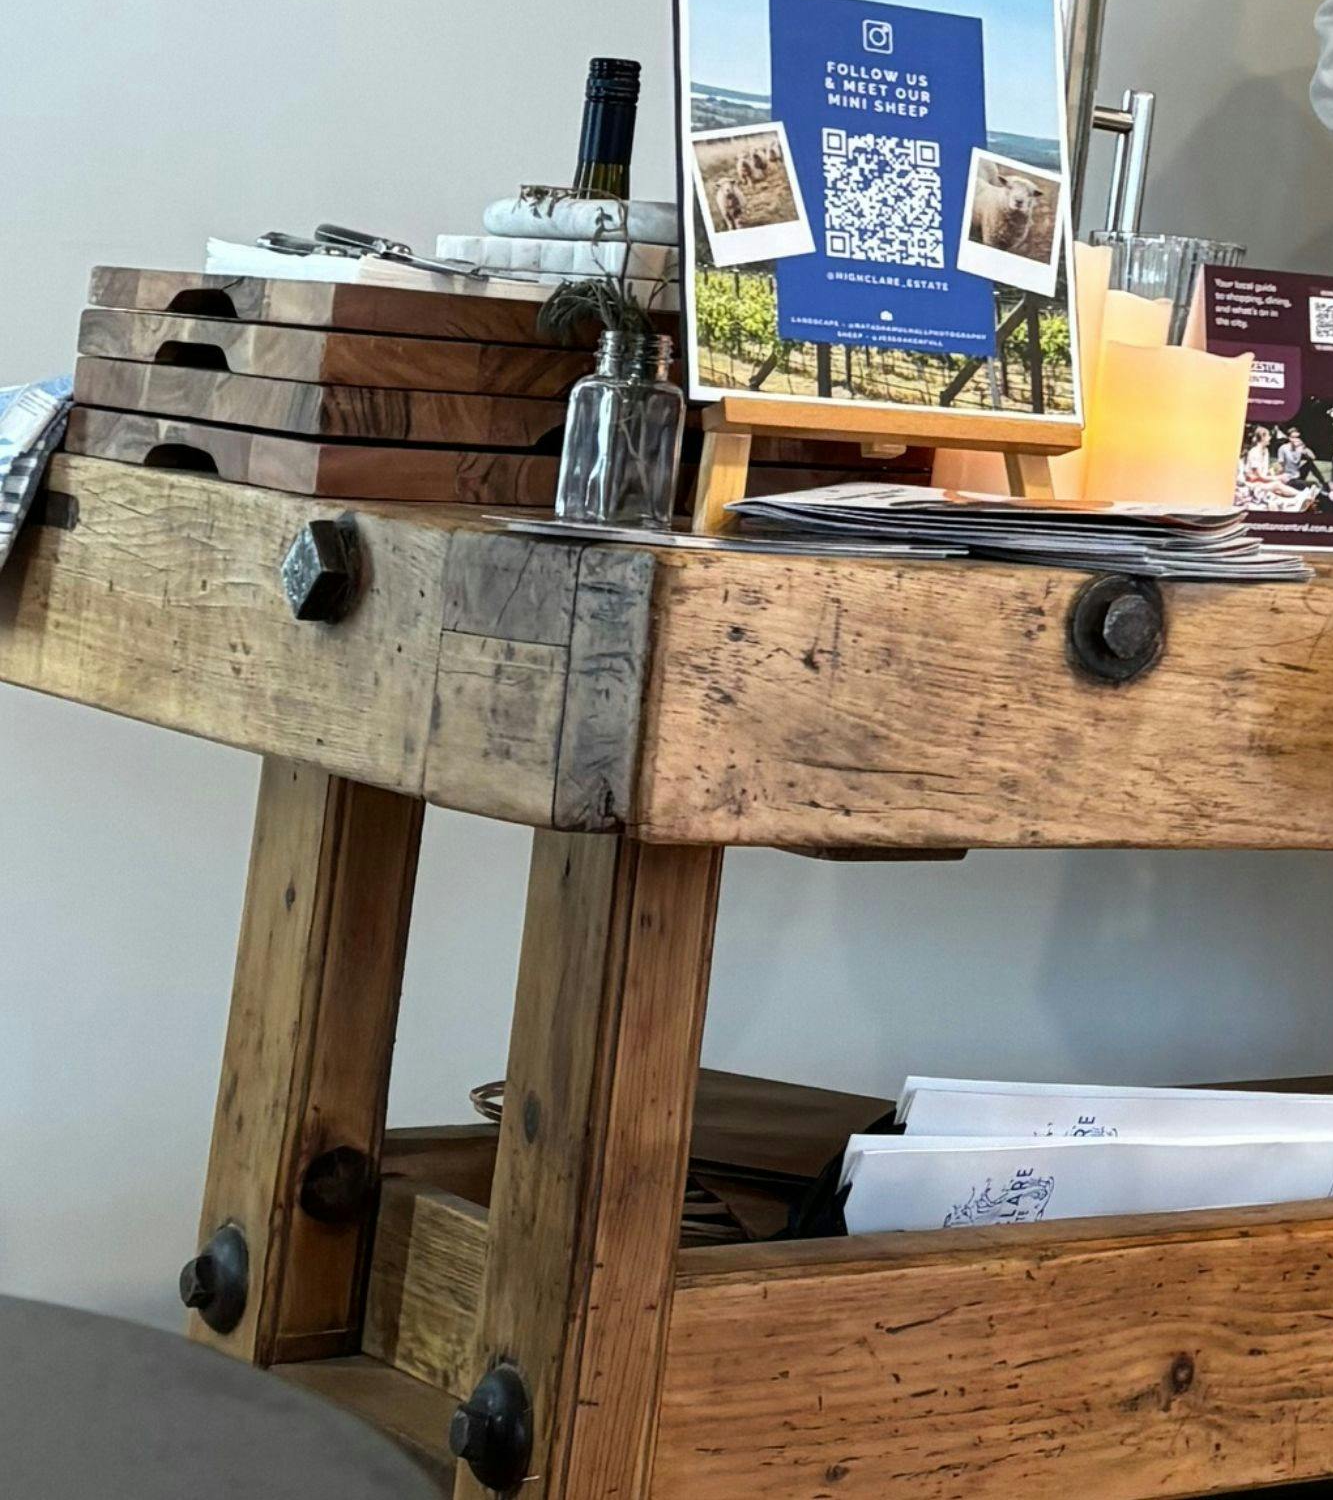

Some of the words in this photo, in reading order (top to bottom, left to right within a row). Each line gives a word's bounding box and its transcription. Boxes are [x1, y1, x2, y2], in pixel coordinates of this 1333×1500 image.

[826, 60, 899, 83] FOLLOW
[905, 72, 929, 87] US
[824, 76, 836, 90] &
[842, 79, 889, 97] MEET
[894, 87, 931, 104] OUR
[827, 92, 868, 110] MINI
[873, 99, 929, 118] SHEEP
[826, 270, 950, 292] @HIGHCLARE_ESTATE
[1214, 277, 1234, 289] Your
[1233, 280, 1255, 291] local
[1254, 282, 1277, 294] guide
[1214, 291, 1226, 301] to
[1214, 304, 1231, 314] and
[1258, 308, 1269, 318] on
[1270, 307, 1280, 318] in
[1214, 316, 1230, 326] the
[836, 330, 864, 340] SHEEP
